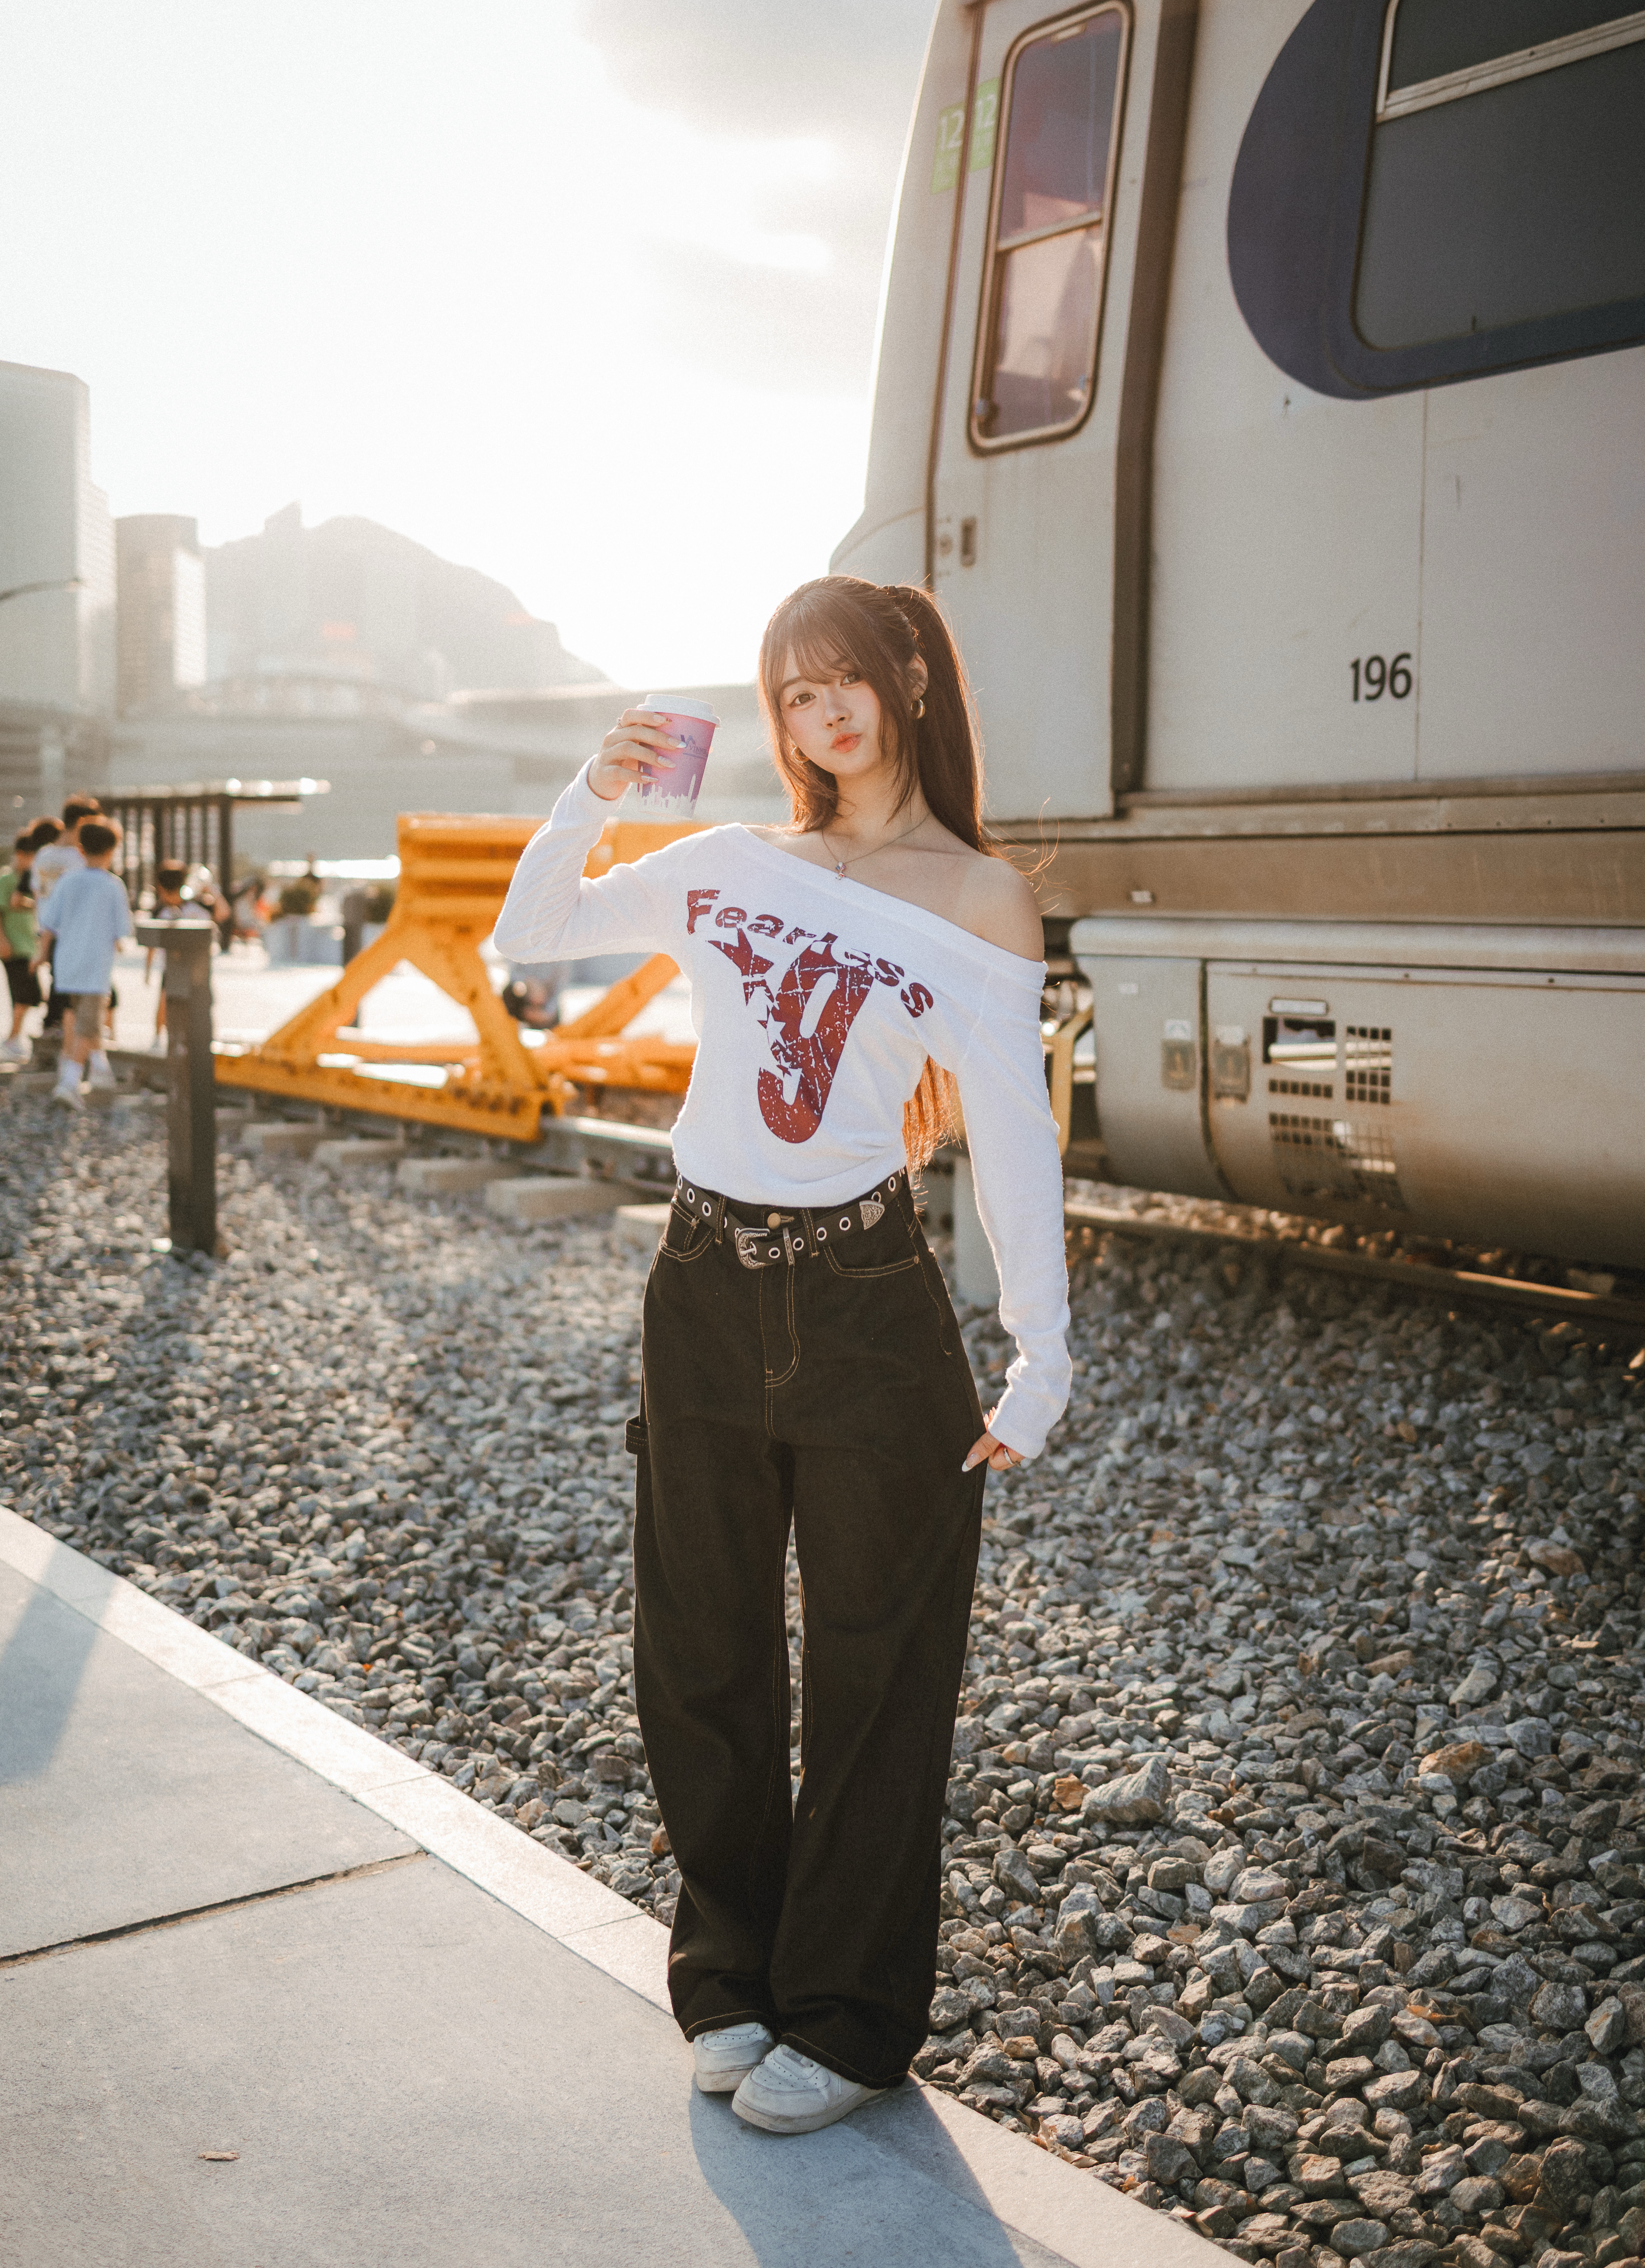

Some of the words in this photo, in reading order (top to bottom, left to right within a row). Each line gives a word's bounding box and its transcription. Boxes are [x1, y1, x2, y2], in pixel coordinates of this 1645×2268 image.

[940, 109, 964, 151] 12
[976, 94, 997, 129] 12
[1350, 652, 1412, 702] 196
[687, 889, 934, 1018] Fearless
